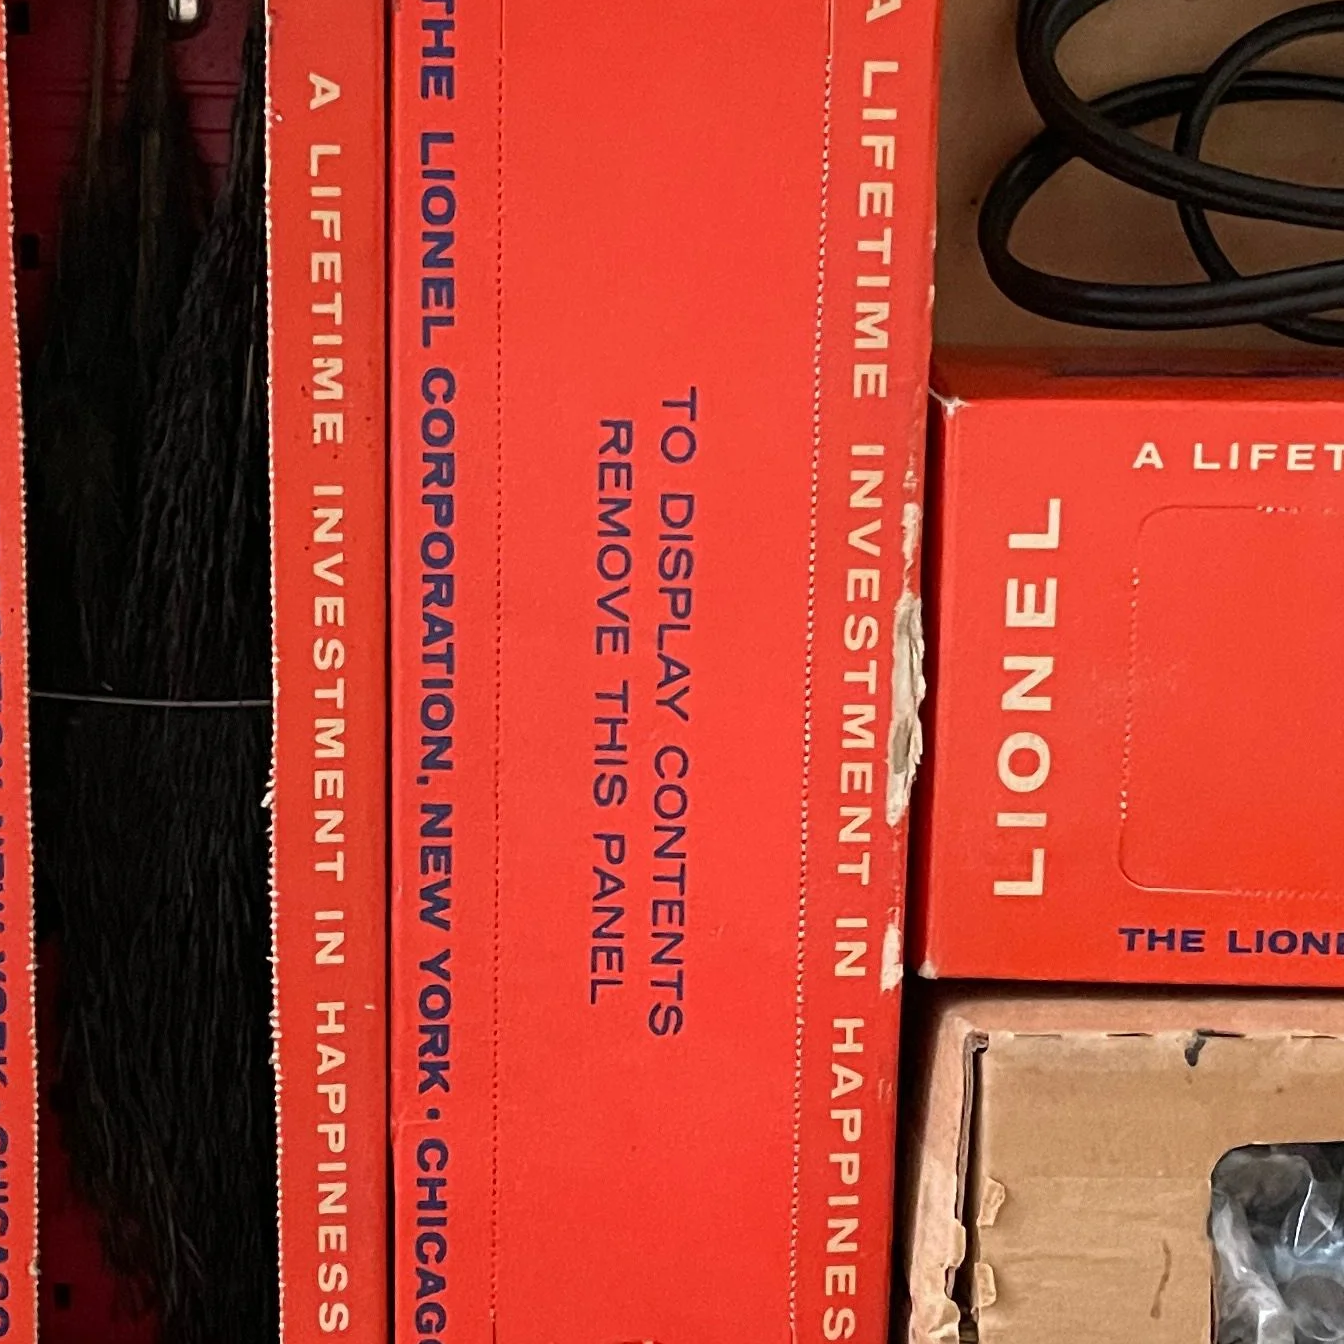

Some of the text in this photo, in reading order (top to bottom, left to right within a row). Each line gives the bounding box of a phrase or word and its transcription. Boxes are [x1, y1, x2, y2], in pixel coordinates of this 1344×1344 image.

[420, 131, 457, 348] LIONEL
[853, 60, 899, 398] LIFETIME
[1132, 442, 1164, 469] A
[308, 72, 349, 1333] A LIFETIME INVESTMENT IN HAPPINESS
[590, 419, 634, 1005] REMOVE THIS PANEL
[648, 386, 698, 1037] TO DISPLAY CONTENTS
[837, 444, 885, 886] INVESTMENT
[993, 498, 1061, 896] LIONEL
[419, 803, 453, 932] NEW
[834, 917, 868, 977] IN
[1118, 927, 1206, 953] THE
[418, 948, 452, 1095] YORK
